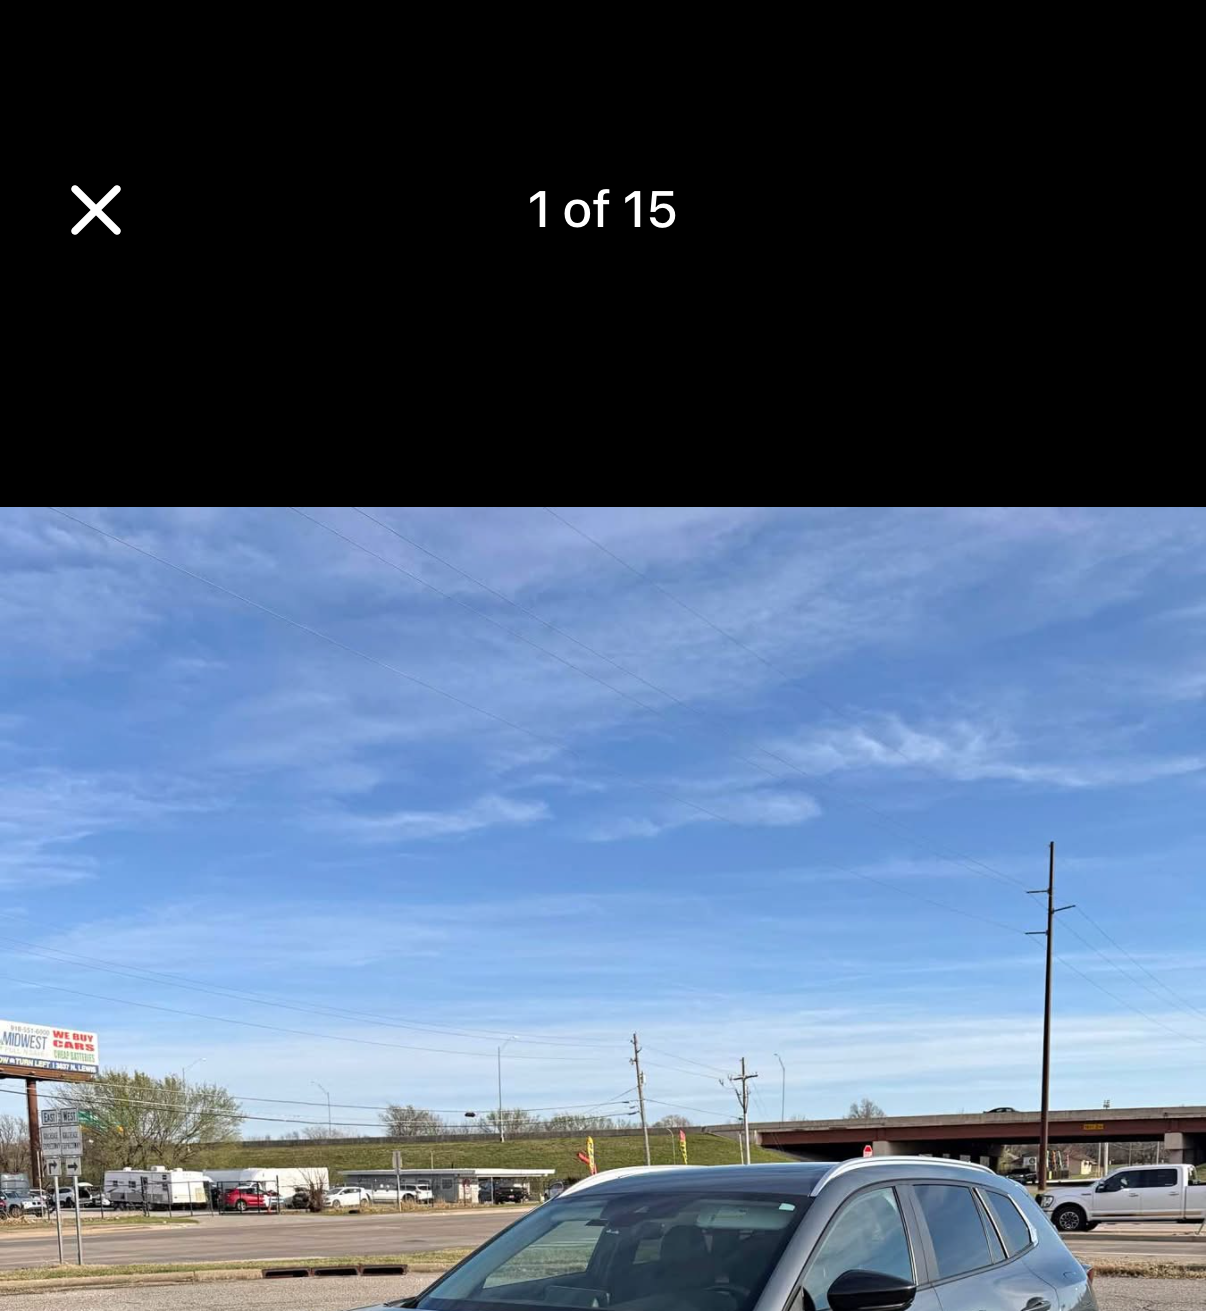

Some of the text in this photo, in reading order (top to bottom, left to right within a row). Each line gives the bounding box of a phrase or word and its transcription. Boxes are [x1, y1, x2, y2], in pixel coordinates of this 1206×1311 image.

[2, 1031, 48, 1050] MIDWEST
[52, 1030, 94, 1042] WE BUY
[52, 1040, 95, 1052] CARS
[35, 1059, 50, 1069] LEFT
[43, 1112, 55, 1122] EAST
[63, 1110, 76, 1121] WEST
